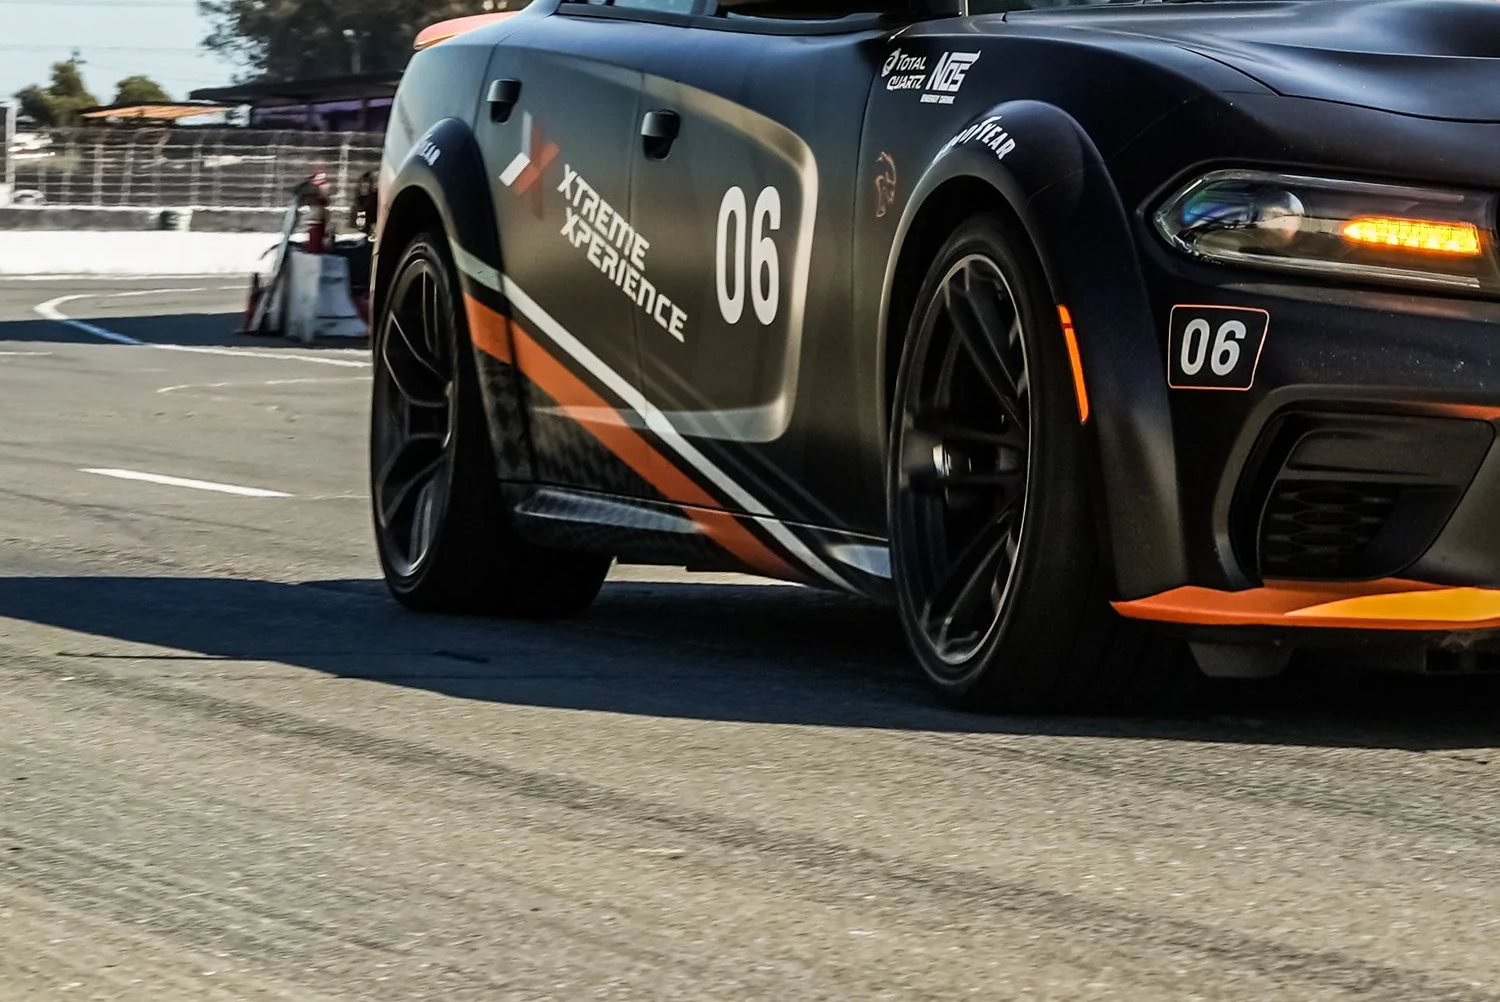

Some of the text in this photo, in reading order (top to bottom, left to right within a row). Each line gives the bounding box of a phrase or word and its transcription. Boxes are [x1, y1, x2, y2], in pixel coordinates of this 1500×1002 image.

[887, 74, 926, 90] QUARTZ
[896, 53, 927, 71] TOTAL
[925, 50, 982, 92] NOS
[557, 164, 650, 271] XTREME
[560, 207, 688, 343] XPERIENCE
[716, 186, 781, 325] 06
[1180, 318, 1247, 376] 06
